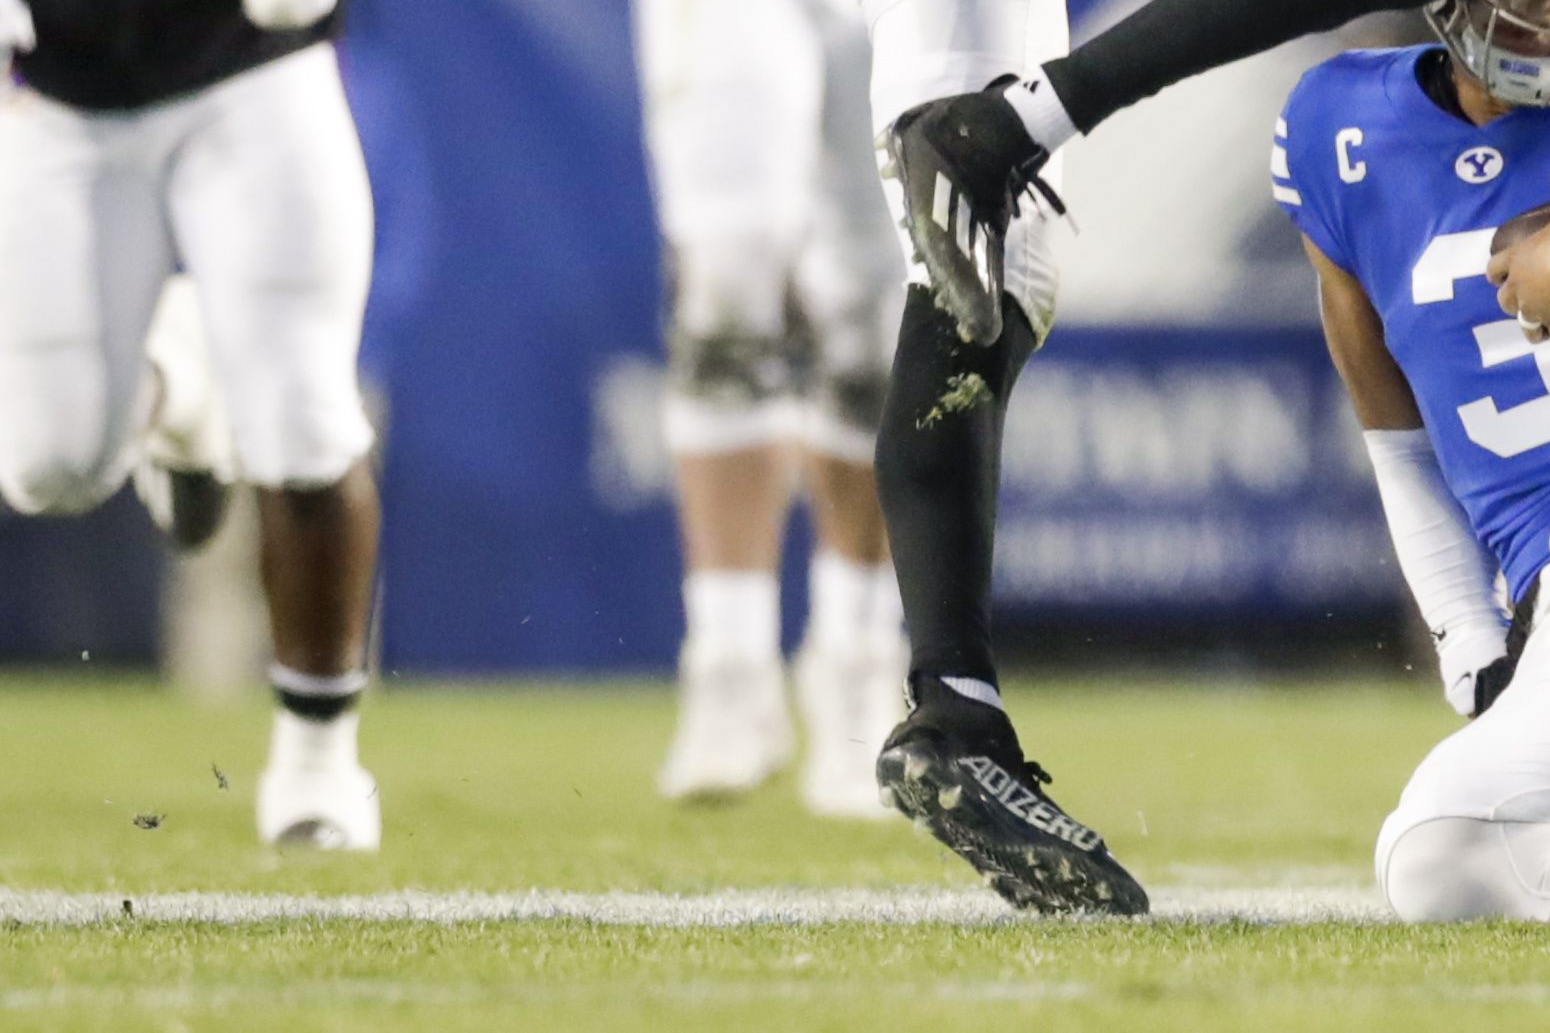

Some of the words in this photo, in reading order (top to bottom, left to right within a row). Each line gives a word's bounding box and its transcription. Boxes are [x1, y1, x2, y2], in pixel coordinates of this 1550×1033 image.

[1335, 127, 1367, 184] C
[1460, 151, 1498, 179] Y
[957, 756, 1104, 852] ADIZERO
